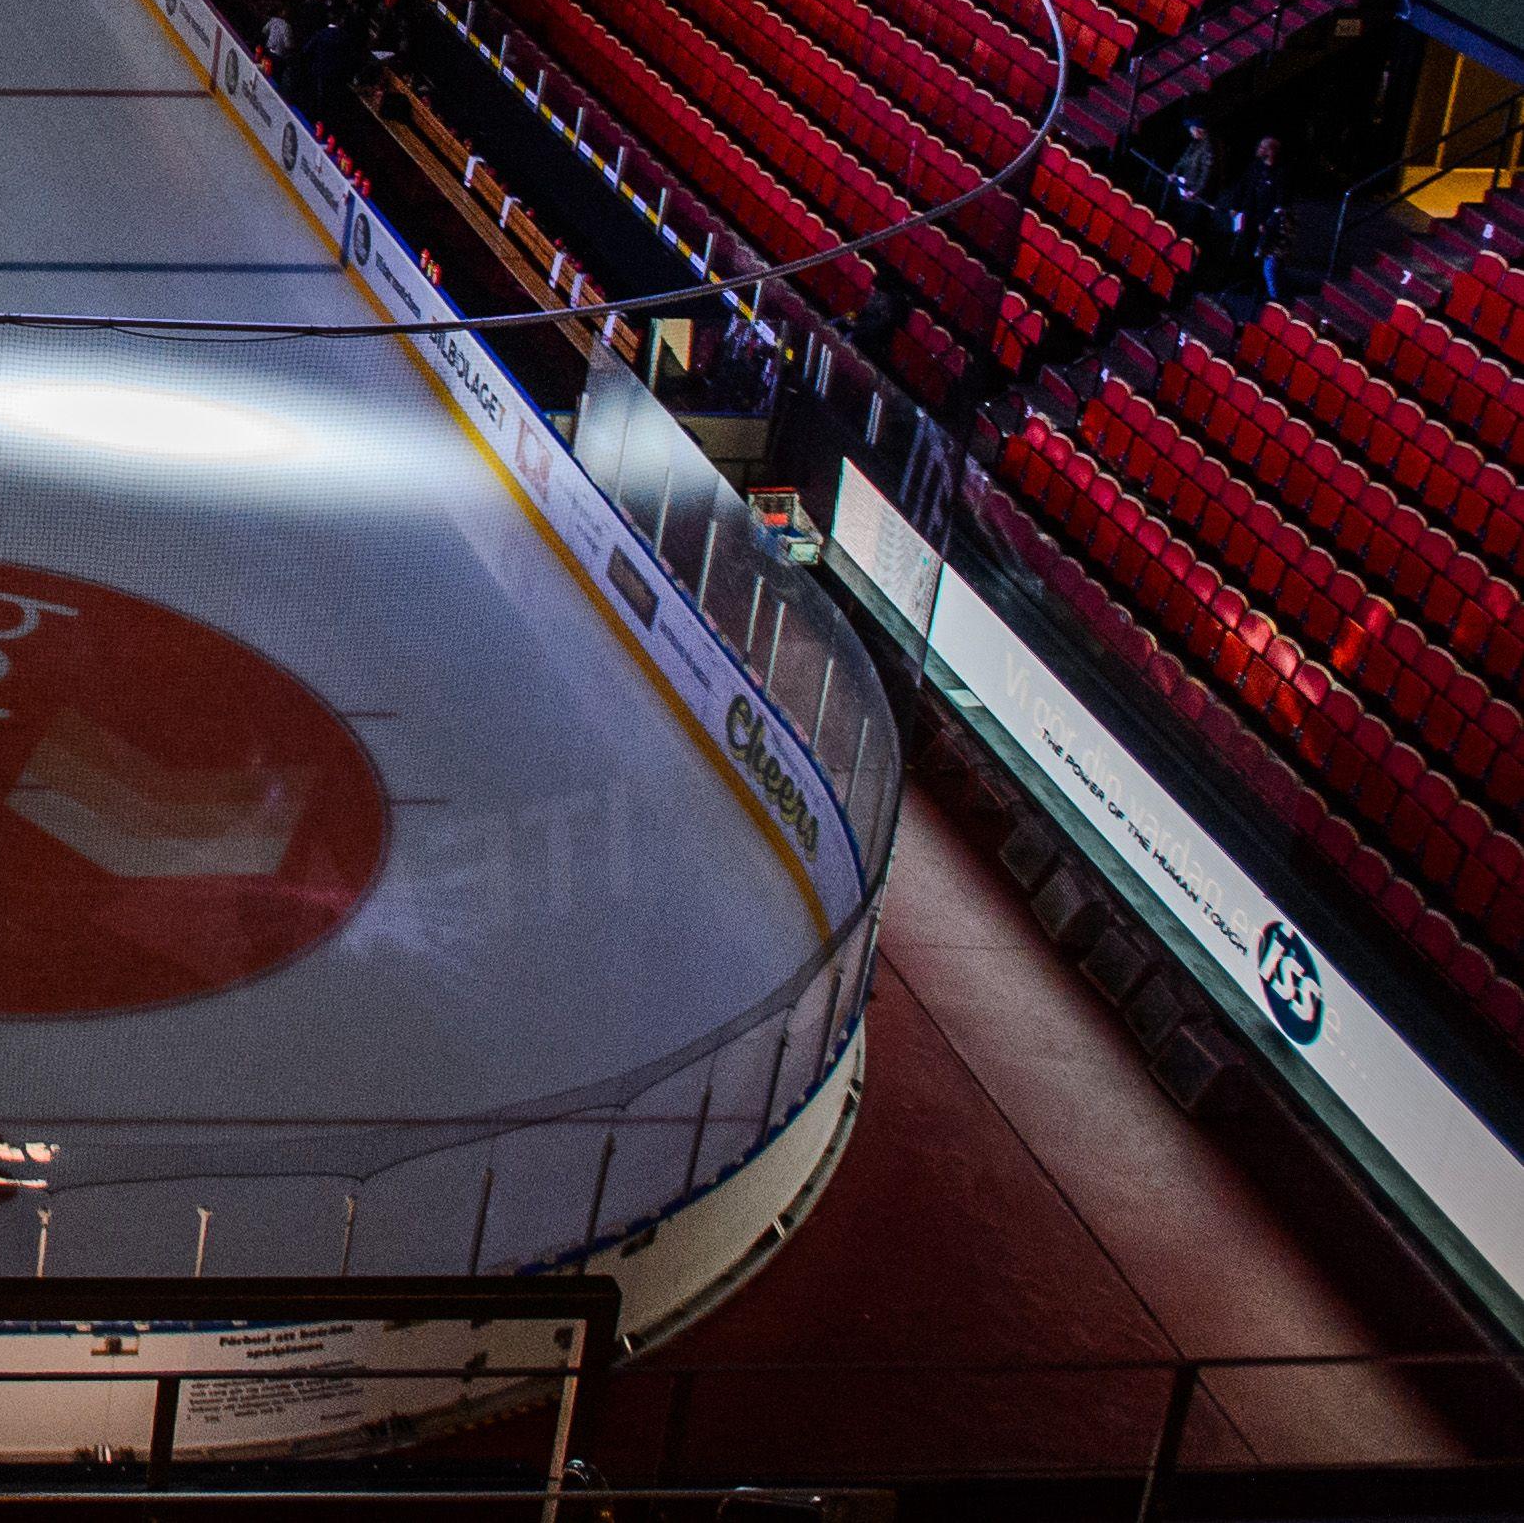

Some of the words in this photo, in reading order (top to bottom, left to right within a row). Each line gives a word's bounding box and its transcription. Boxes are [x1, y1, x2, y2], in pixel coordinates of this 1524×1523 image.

[723, 693, 821, 859] Cheers
[1041, 727, 1065, 759] THE
[1064, 754, 1106, 804] POWER
[1107, 801, 1128, 822] OF
[1127, 820, 1152, 850] THE
[1152, 848, 1202, 903] HUMAN
[1202, 902, 1249, 956] TOUCH
[1258, 926, 1324, 1022] ISS
[218, 1331, 272, 1350] Förbud
[274, 1329, 296, 1344] att
